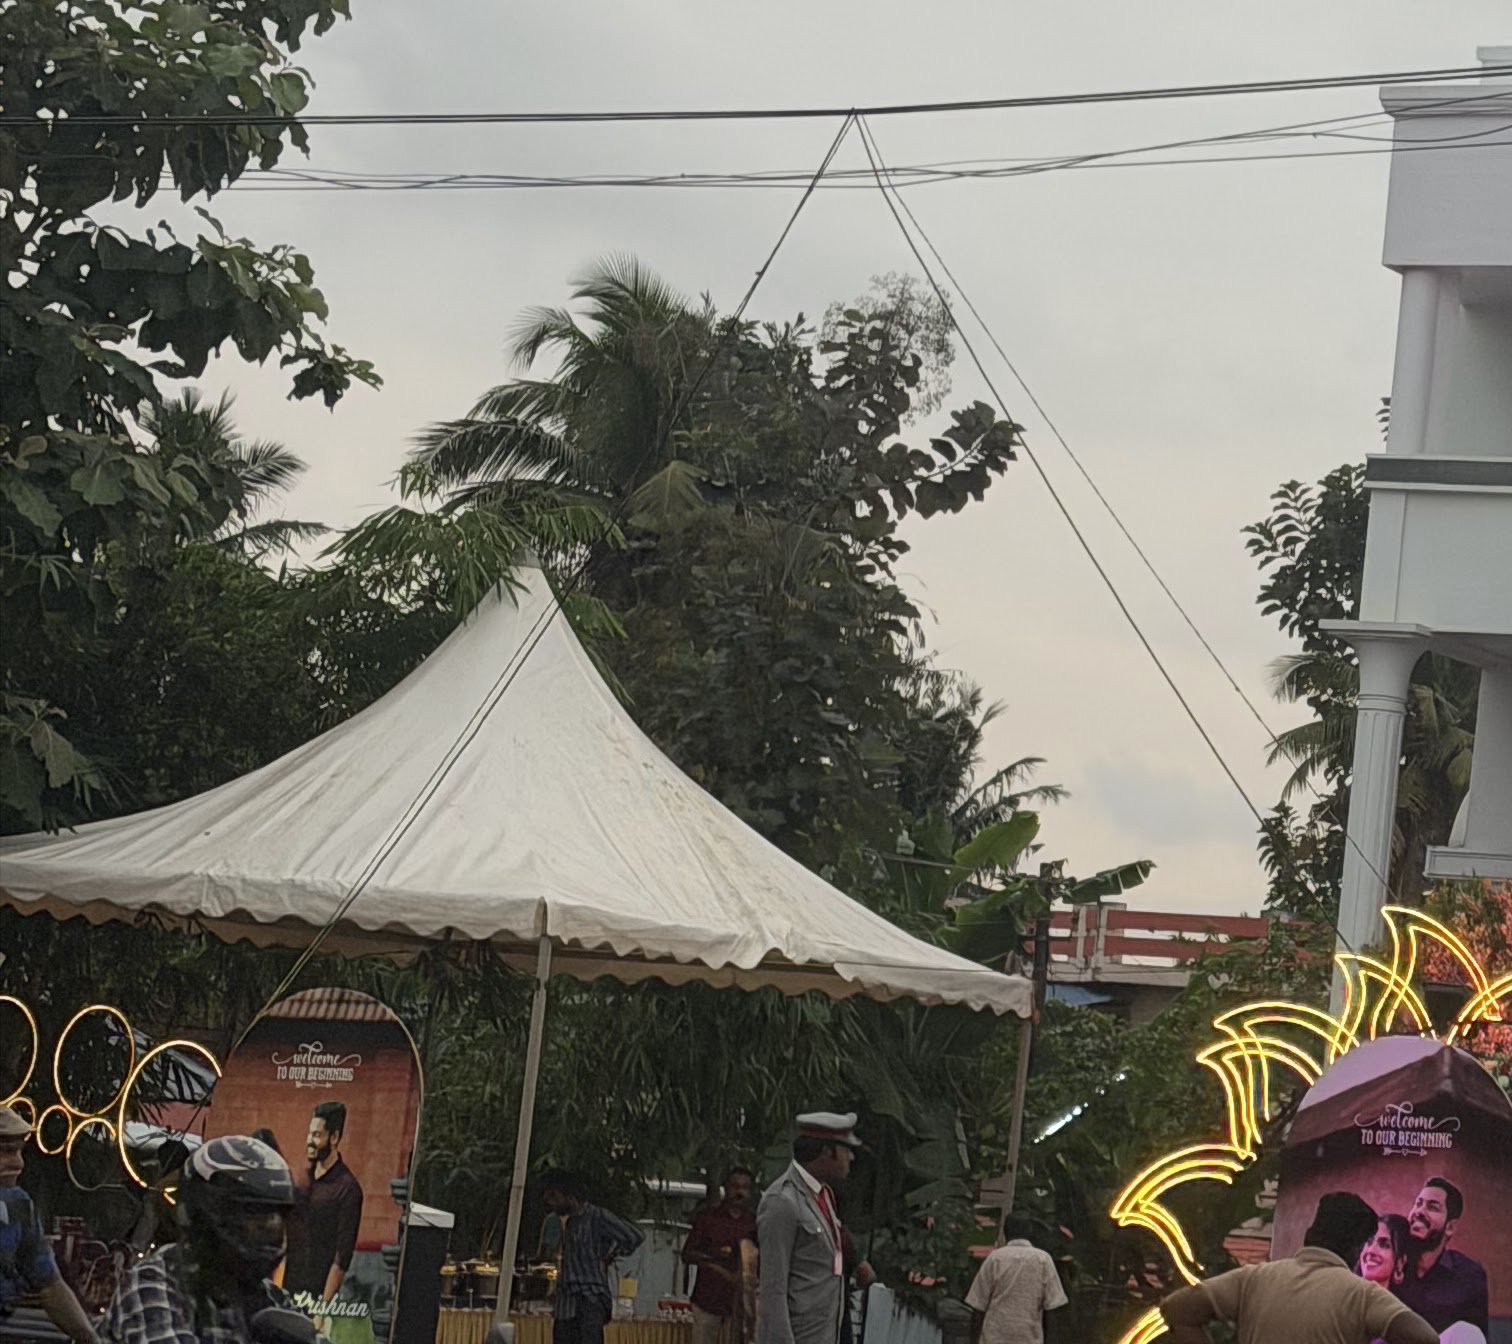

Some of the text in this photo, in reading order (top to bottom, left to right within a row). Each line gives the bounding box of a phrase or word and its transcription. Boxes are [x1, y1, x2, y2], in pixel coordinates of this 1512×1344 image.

[271, 1041, 362, 1067] welcome
[277, 1066, 354, 1082] TO OUR BEGINNING
[1354, 1101, 1462, 1132] welcome
[1361, 1129, 1453, 1149] TO OUR BEGINNING
